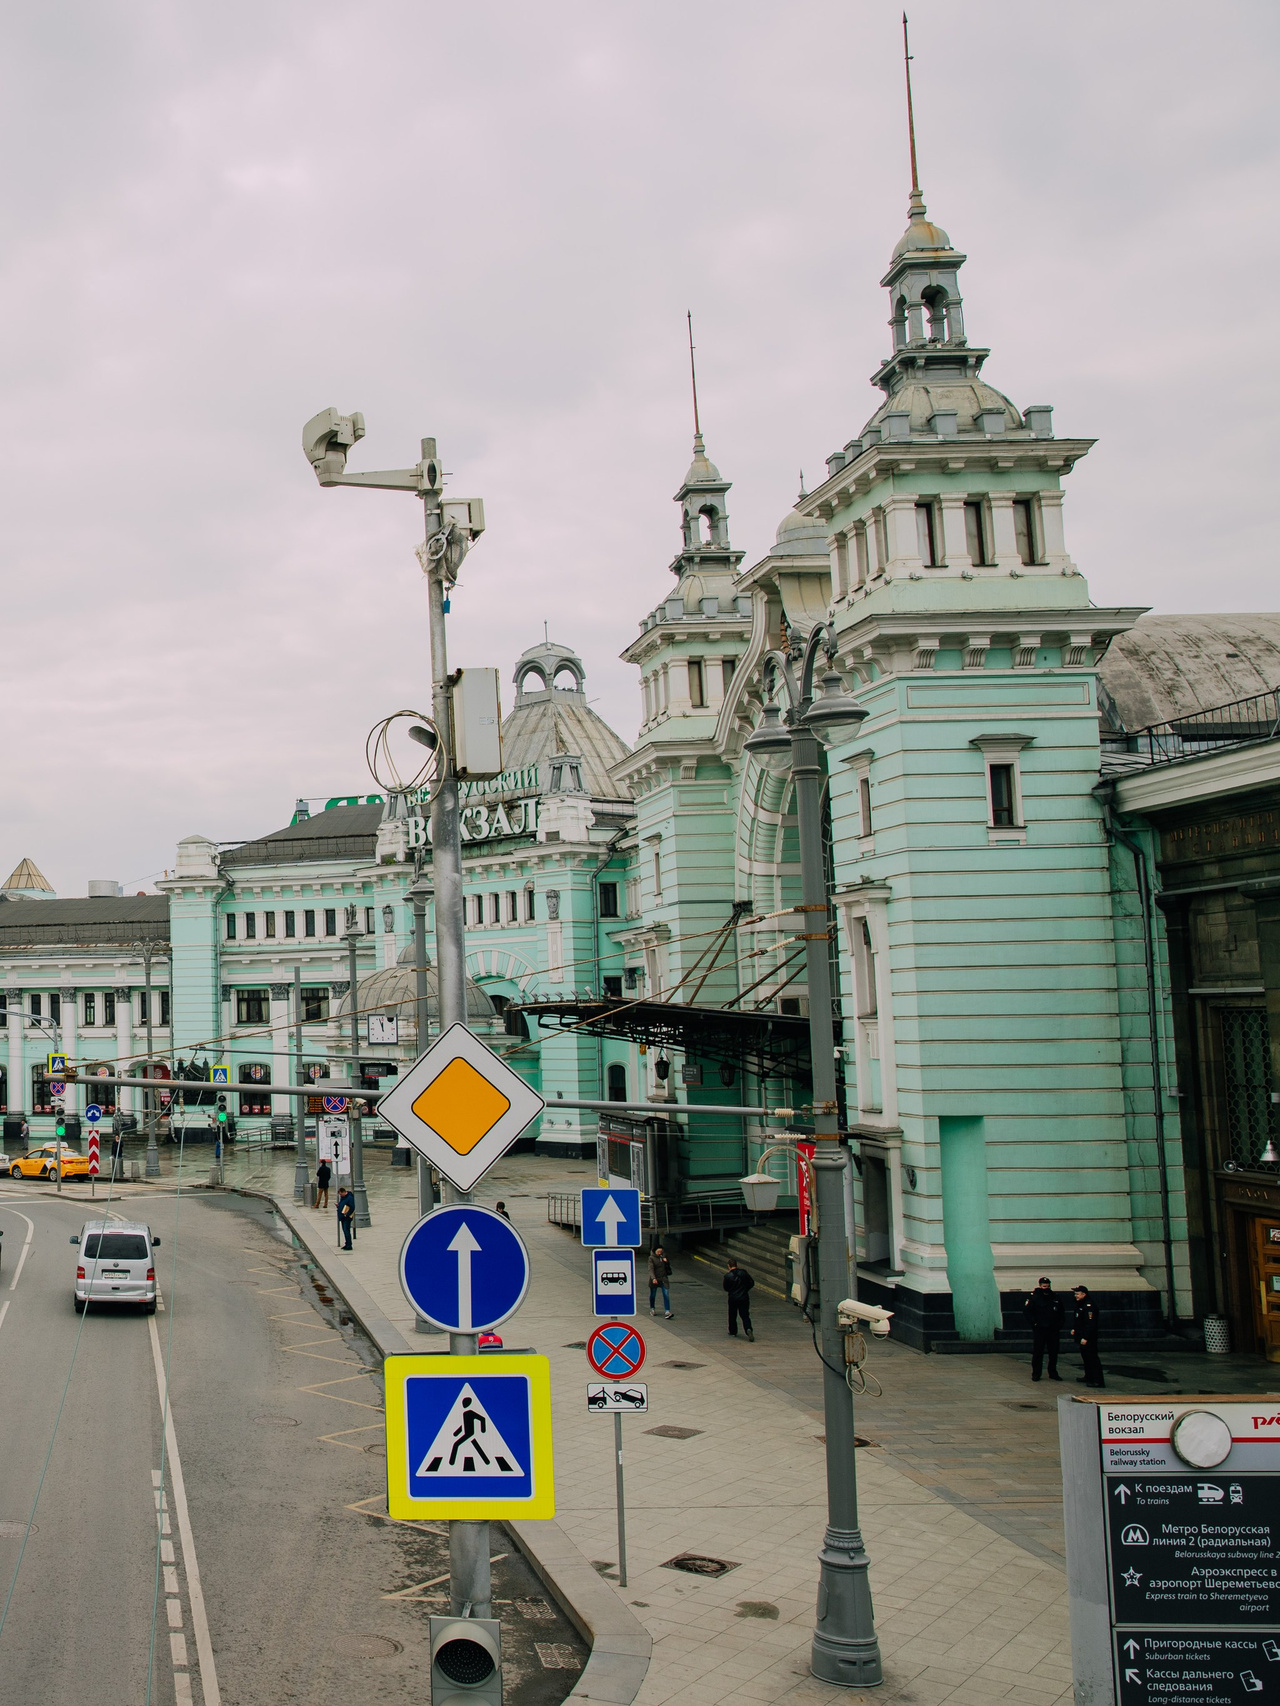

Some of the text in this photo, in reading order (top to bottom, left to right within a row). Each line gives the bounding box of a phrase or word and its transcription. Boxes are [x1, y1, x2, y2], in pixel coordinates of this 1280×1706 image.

[1107, 1411, 1175, 1423] Белорусский
[1108, 1426, 1145, 1434] вокзал
[1109, 1448, 1150, 1458] Belorussky
[1110, 1458, 1166, 1467] railway station
[1135, 1483, 1193, 1494] К поездам
[1136, 1497, 1170, 1505] To trains
[1162, 1524, 1270, 1536] Метро Белорусская
[1152, 1536, 1271, 1548] линия 2 (радиальная)
[1174, 1550, 1226, 1559] Belorusskaya
[1227, 1551, 1259, 1560] subway
[1259, 1551, 1274, 1559] line
[1191, 1566, 1278, 1578] Аэроэкспресс в
[1149, 1579, 1202, 1590] аэропорт
[1145, 1591, 1269, 1602] Express train to Sheremetyevo
[1239, 1603, 1270, 1613] airport
[1144, 1638, 1258, 1650] Пригородные кассы
[1145, 1652, 1211, 1661] Suburban tickets
[1146, 1668, 1234, 1680] Кассы дальнего
[1147, 1682, 1213, 1692] следования
[1148, 1695, 1232, 1705] Long-distance tickets
